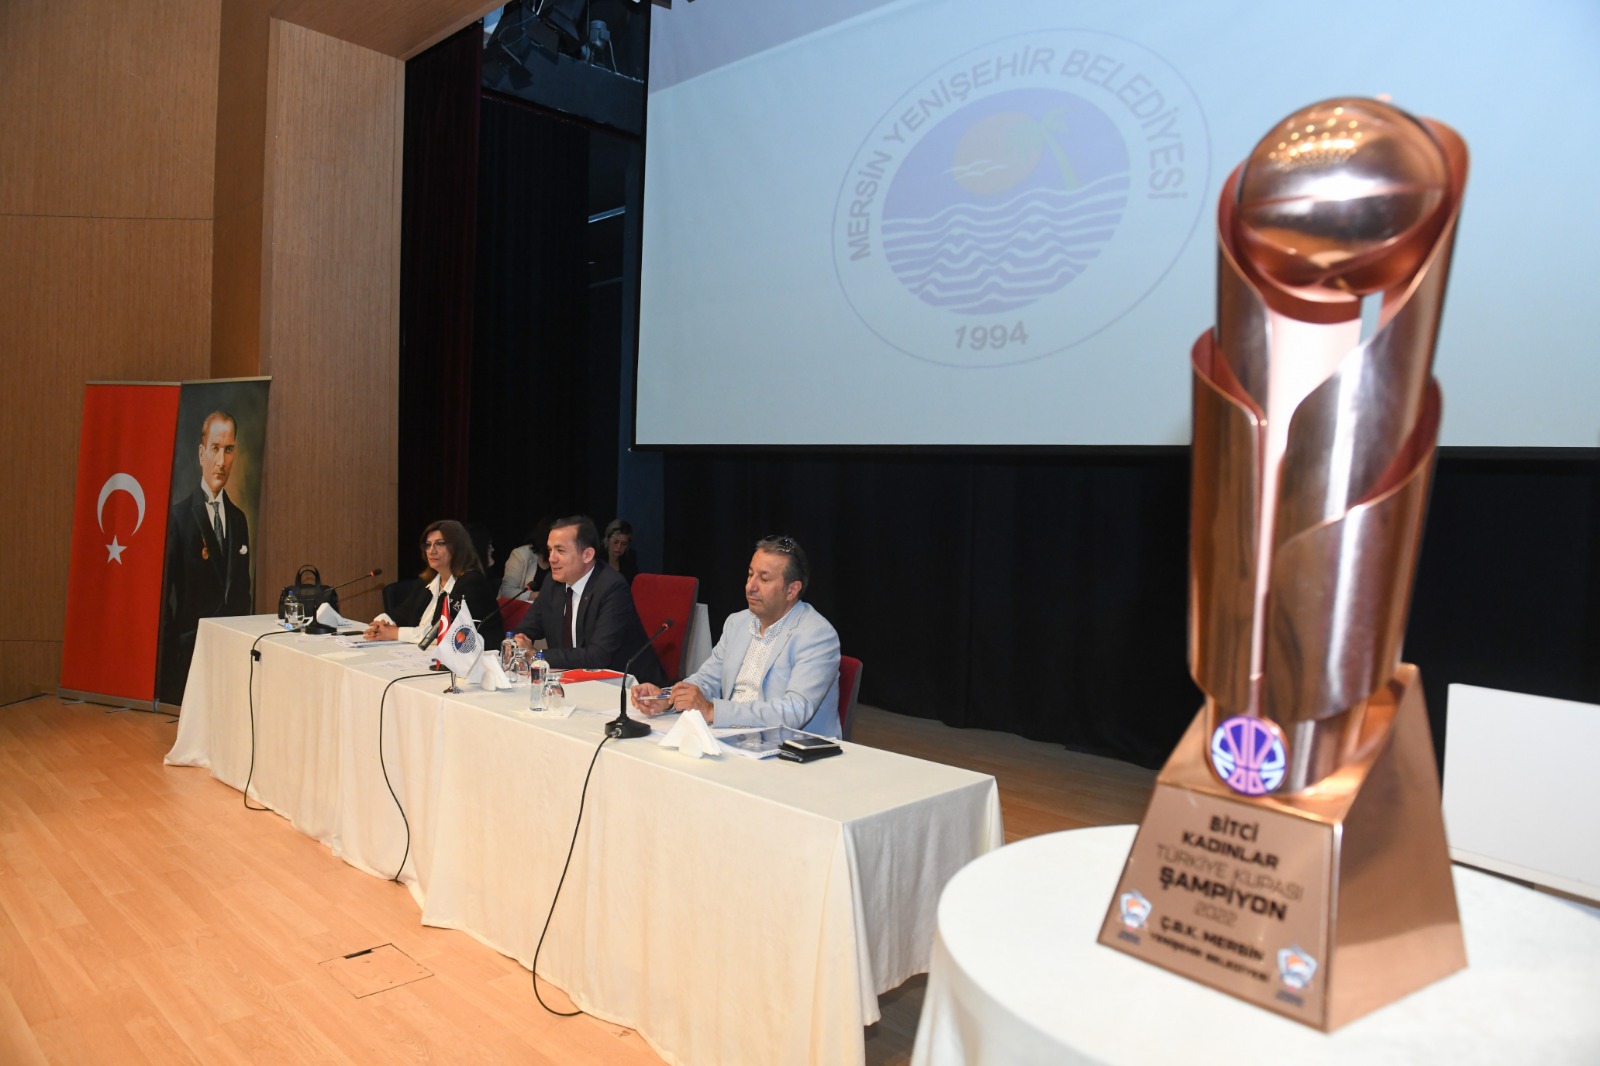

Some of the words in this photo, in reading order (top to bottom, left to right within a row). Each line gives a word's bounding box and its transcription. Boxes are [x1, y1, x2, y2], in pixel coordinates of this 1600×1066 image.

[847, 149, 893, 262] MERSİN
[1059, 48, 1188, 201] BELEDİYESİ
[954, 321, 1029, 351] 1994
[1209, 814, 1260, 843] BİTCİ
[1181, 830, 1280, 871] KADINLAR
[1159, 865, 1288, 922] ŞAMPİYON
[1233, 865, 1304, 902] KUPASI
